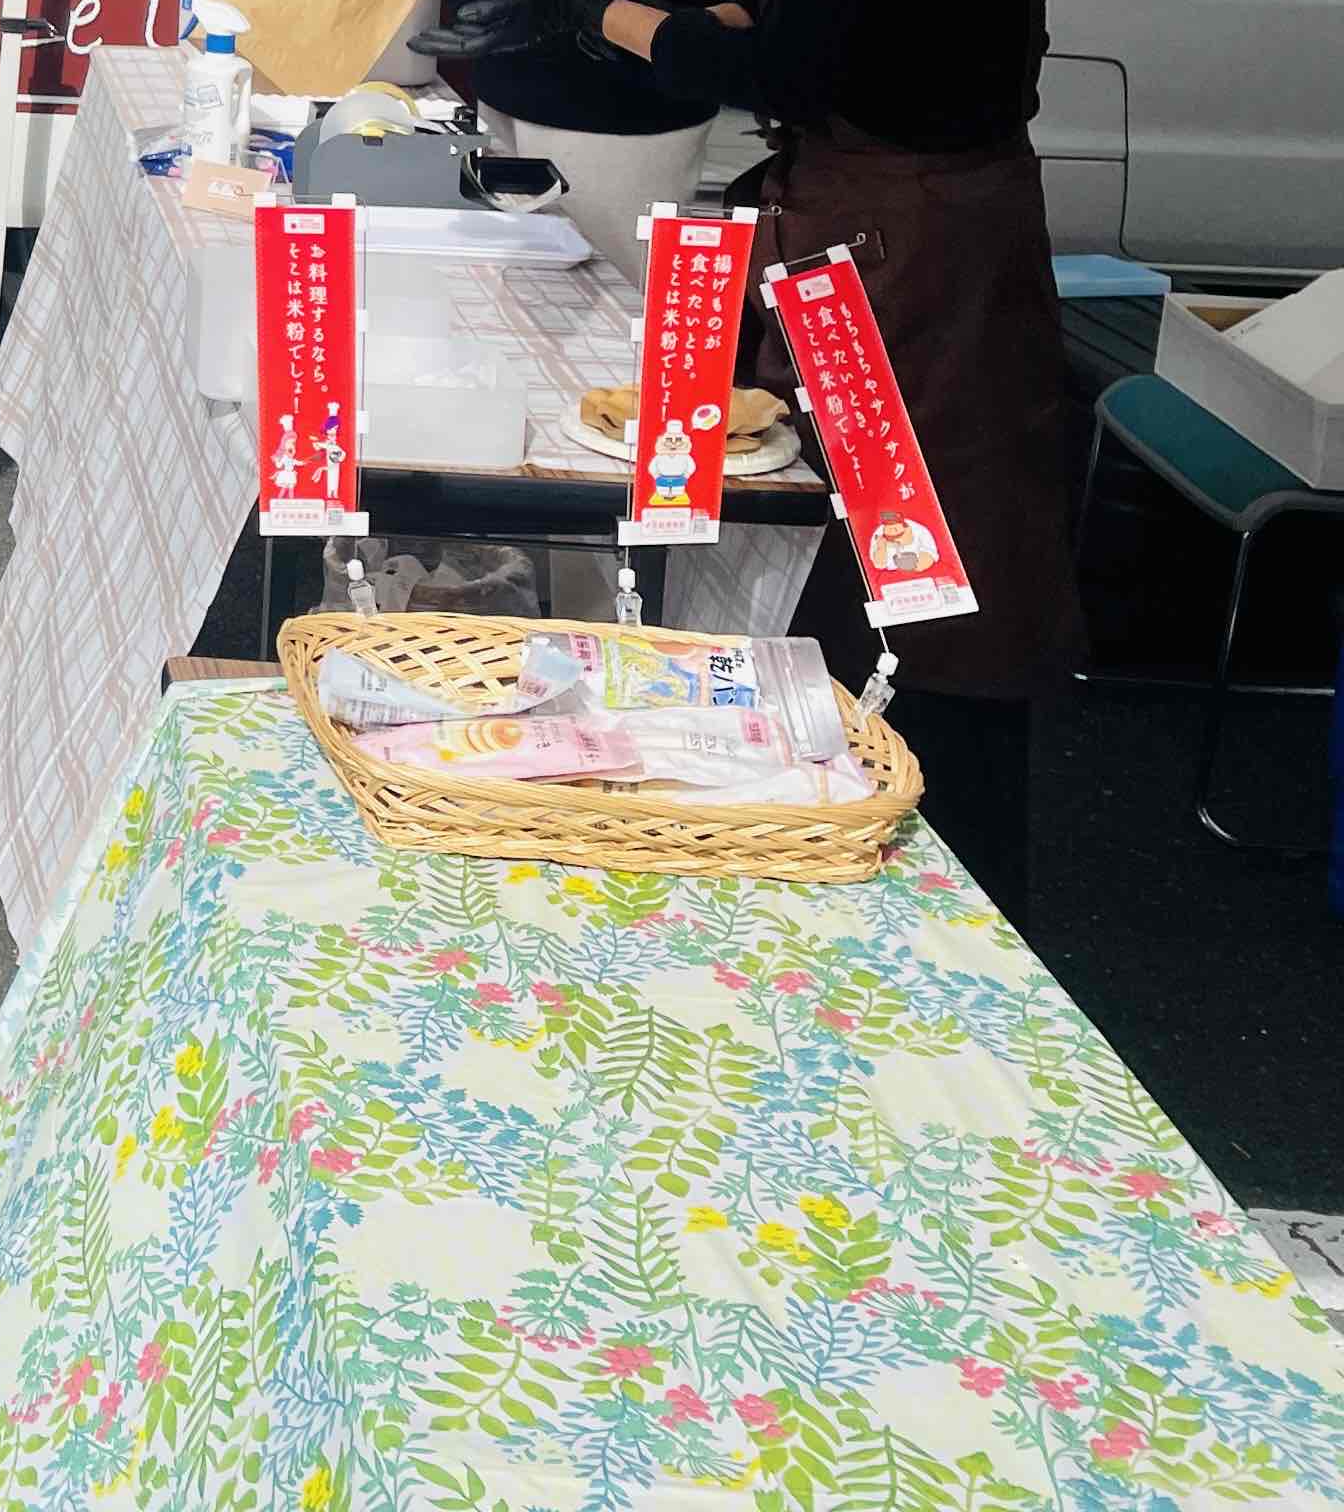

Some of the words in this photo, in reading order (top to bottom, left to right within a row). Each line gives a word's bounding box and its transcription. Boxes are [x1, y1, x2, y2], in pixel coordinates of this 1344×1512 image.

[308, 243, 329, 393] お料理するなら。
[683, 252, 711, 381] 食べたいとき。
[703, 253, 733, 351] 揚げものが
[817, 305, 876, 440] 食べたいとき。
[839, 301, 916, 502] もちもちやサクサクが
